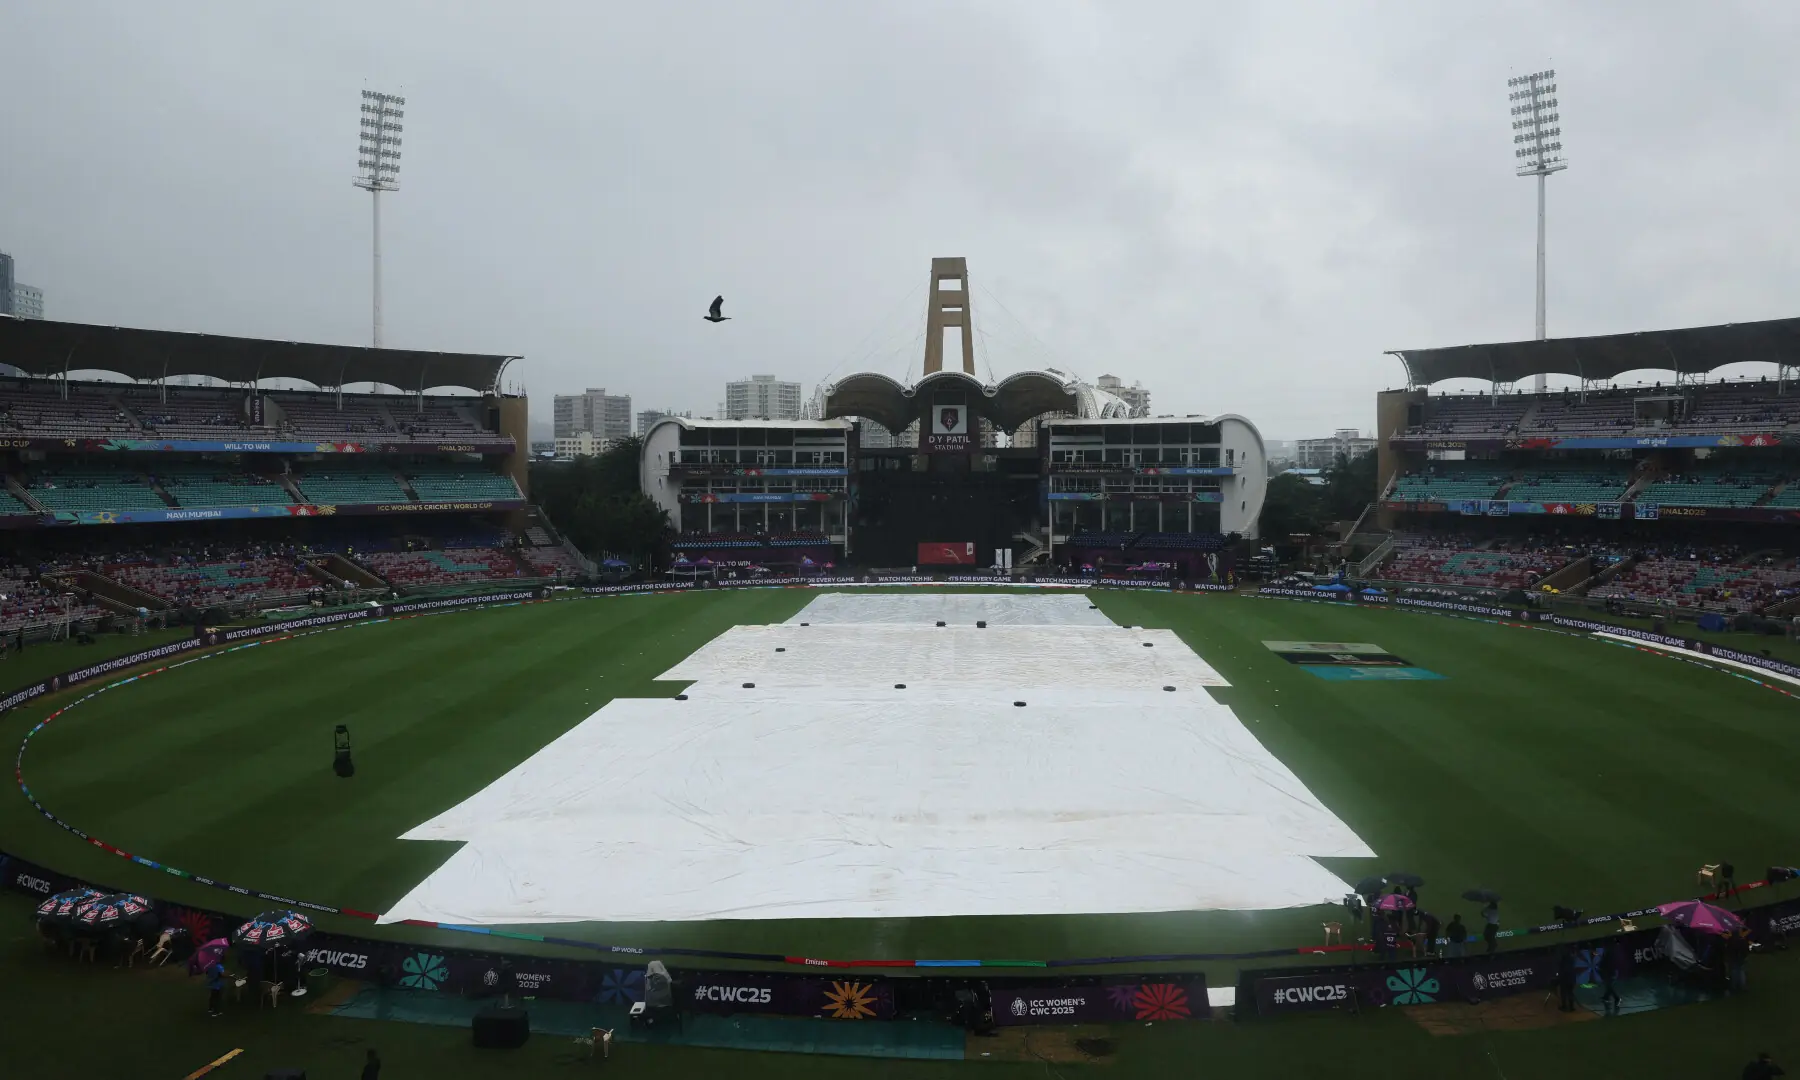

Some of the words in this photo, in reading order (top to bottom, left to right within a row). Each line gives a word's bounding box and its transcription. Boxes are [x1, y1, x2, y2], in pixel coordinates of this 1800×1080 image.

[929, 436, 935, 444] D
[937, 436, 943, 444] Y
[946, 436, 971, 444] PATIL
[166, 512, 188, 520] NAVI
[604, 584, 640, 592] HIGHLIGHTS
[393, 603, 417, 612] WATCH
[418, 600, 442, 610] MATCH
[442, 596, 477, 607] HIGHLIGHTS
[478, 595, 490, 603] FOR
[492, 593, 512, 601] EVERY
[1414, 599, 1453, 609] HIGHLIGHTS
[1468, 605, 1490, 614] EVERY
[1491, 608, 1512, 617] GAME
[226, 630, 250, 640] WATCH
[251, 625, 274, 635] MATCH
[274, 619, 312, 631] HIGHLIGHTS
[328, 614, 348, 622] EVERY
[349, 610, 368, 619] GAME
[1540, 613, 1562, 624] WATCH
[1563, 618, 1587, 628] MATCH
[1588, 622, 1627, 635] HIGHLIGHTS
[1628, 629, 1641, 638] FOR
[1642, 631, 1664, 642] EVERY
[1665, 636, 1685, 647] GAME
[68, 669, 89, 682] WATCH
[90, 662, 112, 676] MATCH
[112, 652, 147, 669] HIGHLIGHTS
[148, 649, 160, 659] FOR
[161, 643, 180, 655] EVERY
[182, 638, 200, 648] GAME
[1712, 646, 1736, 660] WATCH
[1737, 652, 1763, 665] MATCH
[1762, 658, 1800, 676] HIGHLIGHTS
[4, 697, 12, 708] FOR
[13, 689, 28, 705] EVERY
[29, 683, 45, 697] GAME
[16, 873, 50, 893] #CWC25
[307, 948, 368, 969] #CWC25
[805, 958, 828, 966] Emirates
[516, 972, 551, 981] WOMEN'S
[1487, 972, 1500, 980] ICC
[1501, 968, 1533, 979] WOMEN'S
[1507, 977, 1526, 986] 2025
[518, 981, 540, 989] 2025
[694, 985, 772, 1004] #CWC25
[1030, 999, 1044, 1007] ICC
[1045, 998, 1086, 1007] WOMEN'S
[1273, 985, 1347, 1004] #CWC25
[1030, 1008, 1051, 1016] CWC
[1052, 1006, 1075, 1015] 2025
